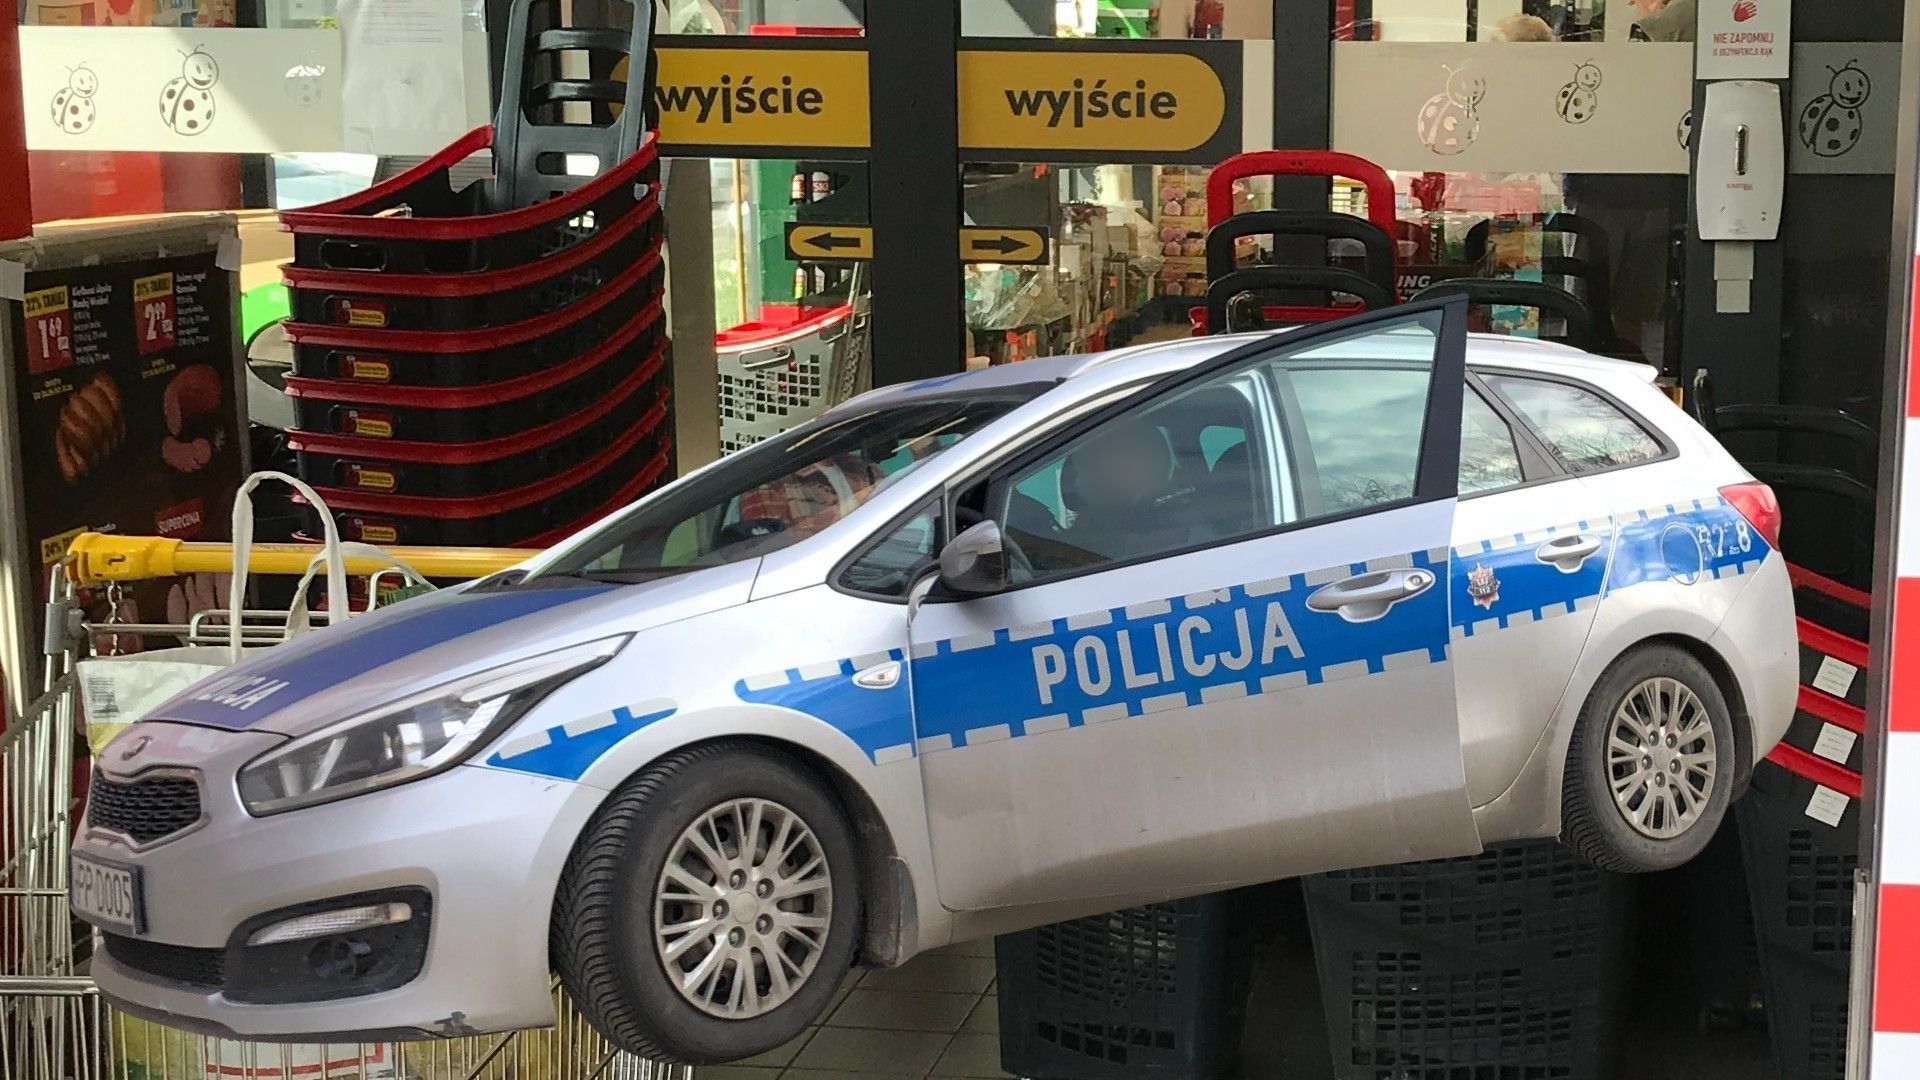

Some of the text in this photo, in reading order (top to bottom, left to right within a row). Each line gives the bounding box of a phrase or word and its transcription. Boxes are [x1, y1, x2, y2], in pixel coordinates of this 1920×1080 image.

[1713, 32, 1774, 44] NIE ZAPOMNIJ
[656, 74, 824, 124] wyjście
[1004, 78, 1178, 128] wyjście
[1031, 600, 1305, 705] POLICJA
